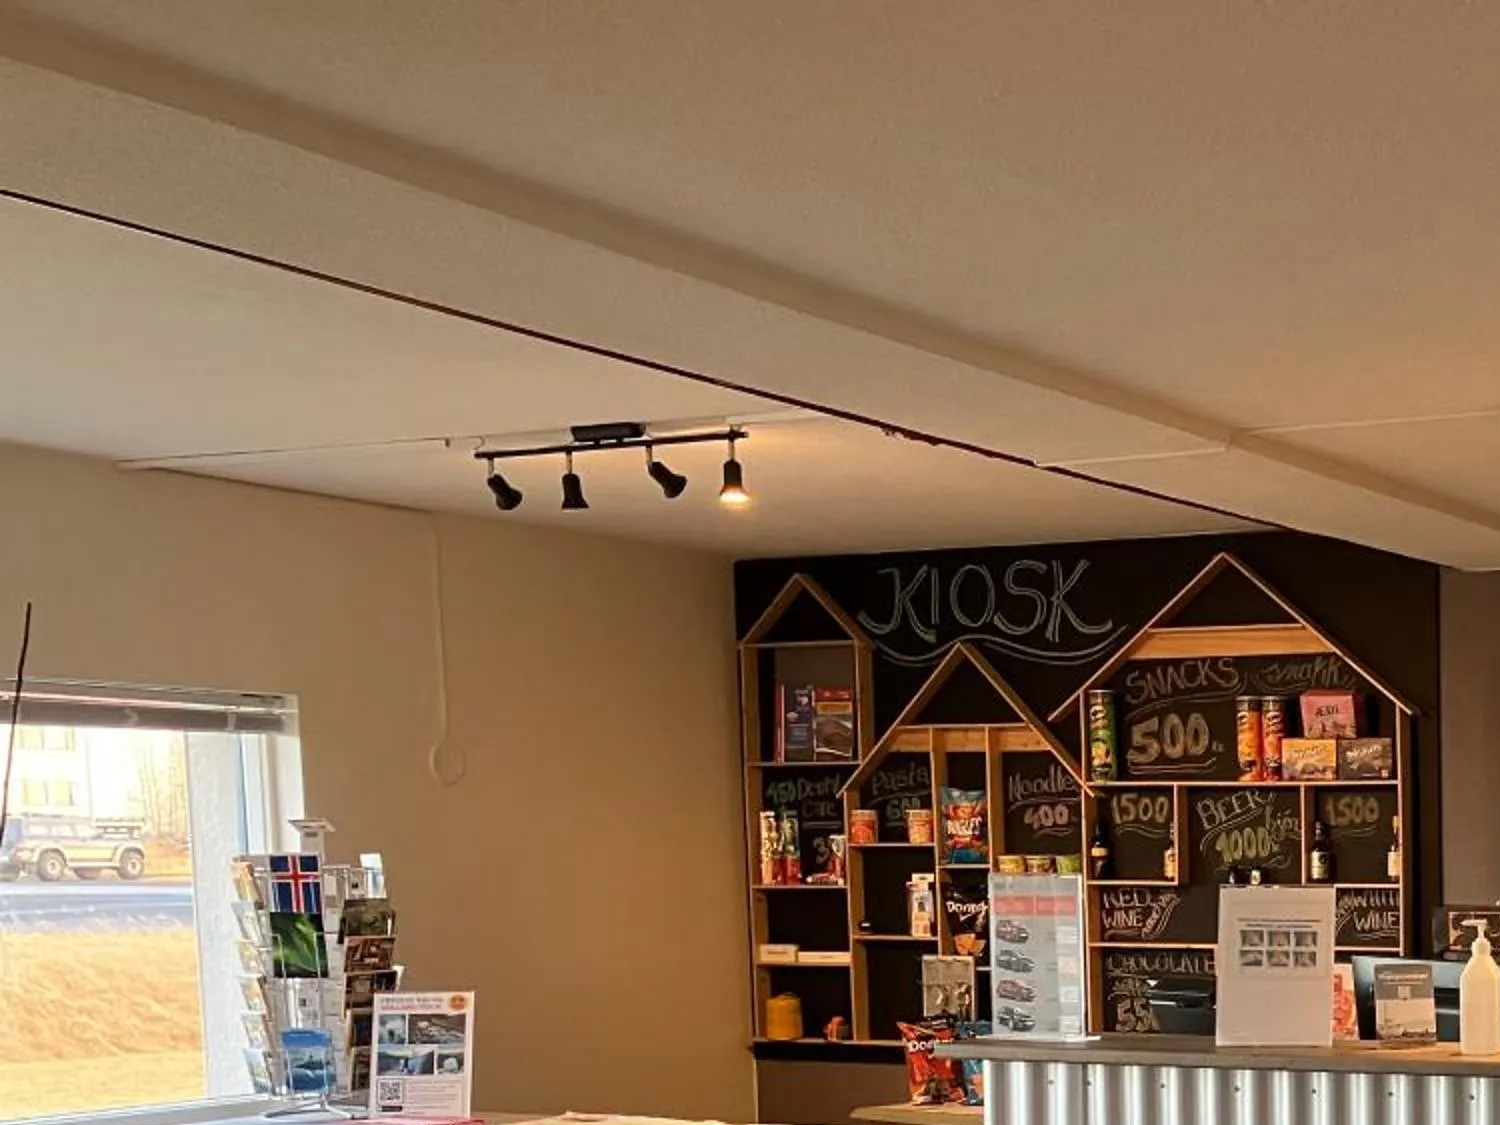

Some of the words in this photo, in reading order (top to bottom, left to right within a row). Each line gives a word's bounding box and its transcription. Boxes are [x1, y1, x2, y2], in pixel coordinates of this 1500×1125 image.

[857, 558, 1113, 644] KIOSK
[1126, 657, 1240, 705] SNACKS
[1127, 711, 1210, 764] 500
[1024, 804, 1070, 830] 400
[1110, 792, 1169, 825] 1500
[1325, 795, 1380, 826] 1500
[1102, 909, 1144, 929] WINE
[1354, 911, 1400, 931] WINE
